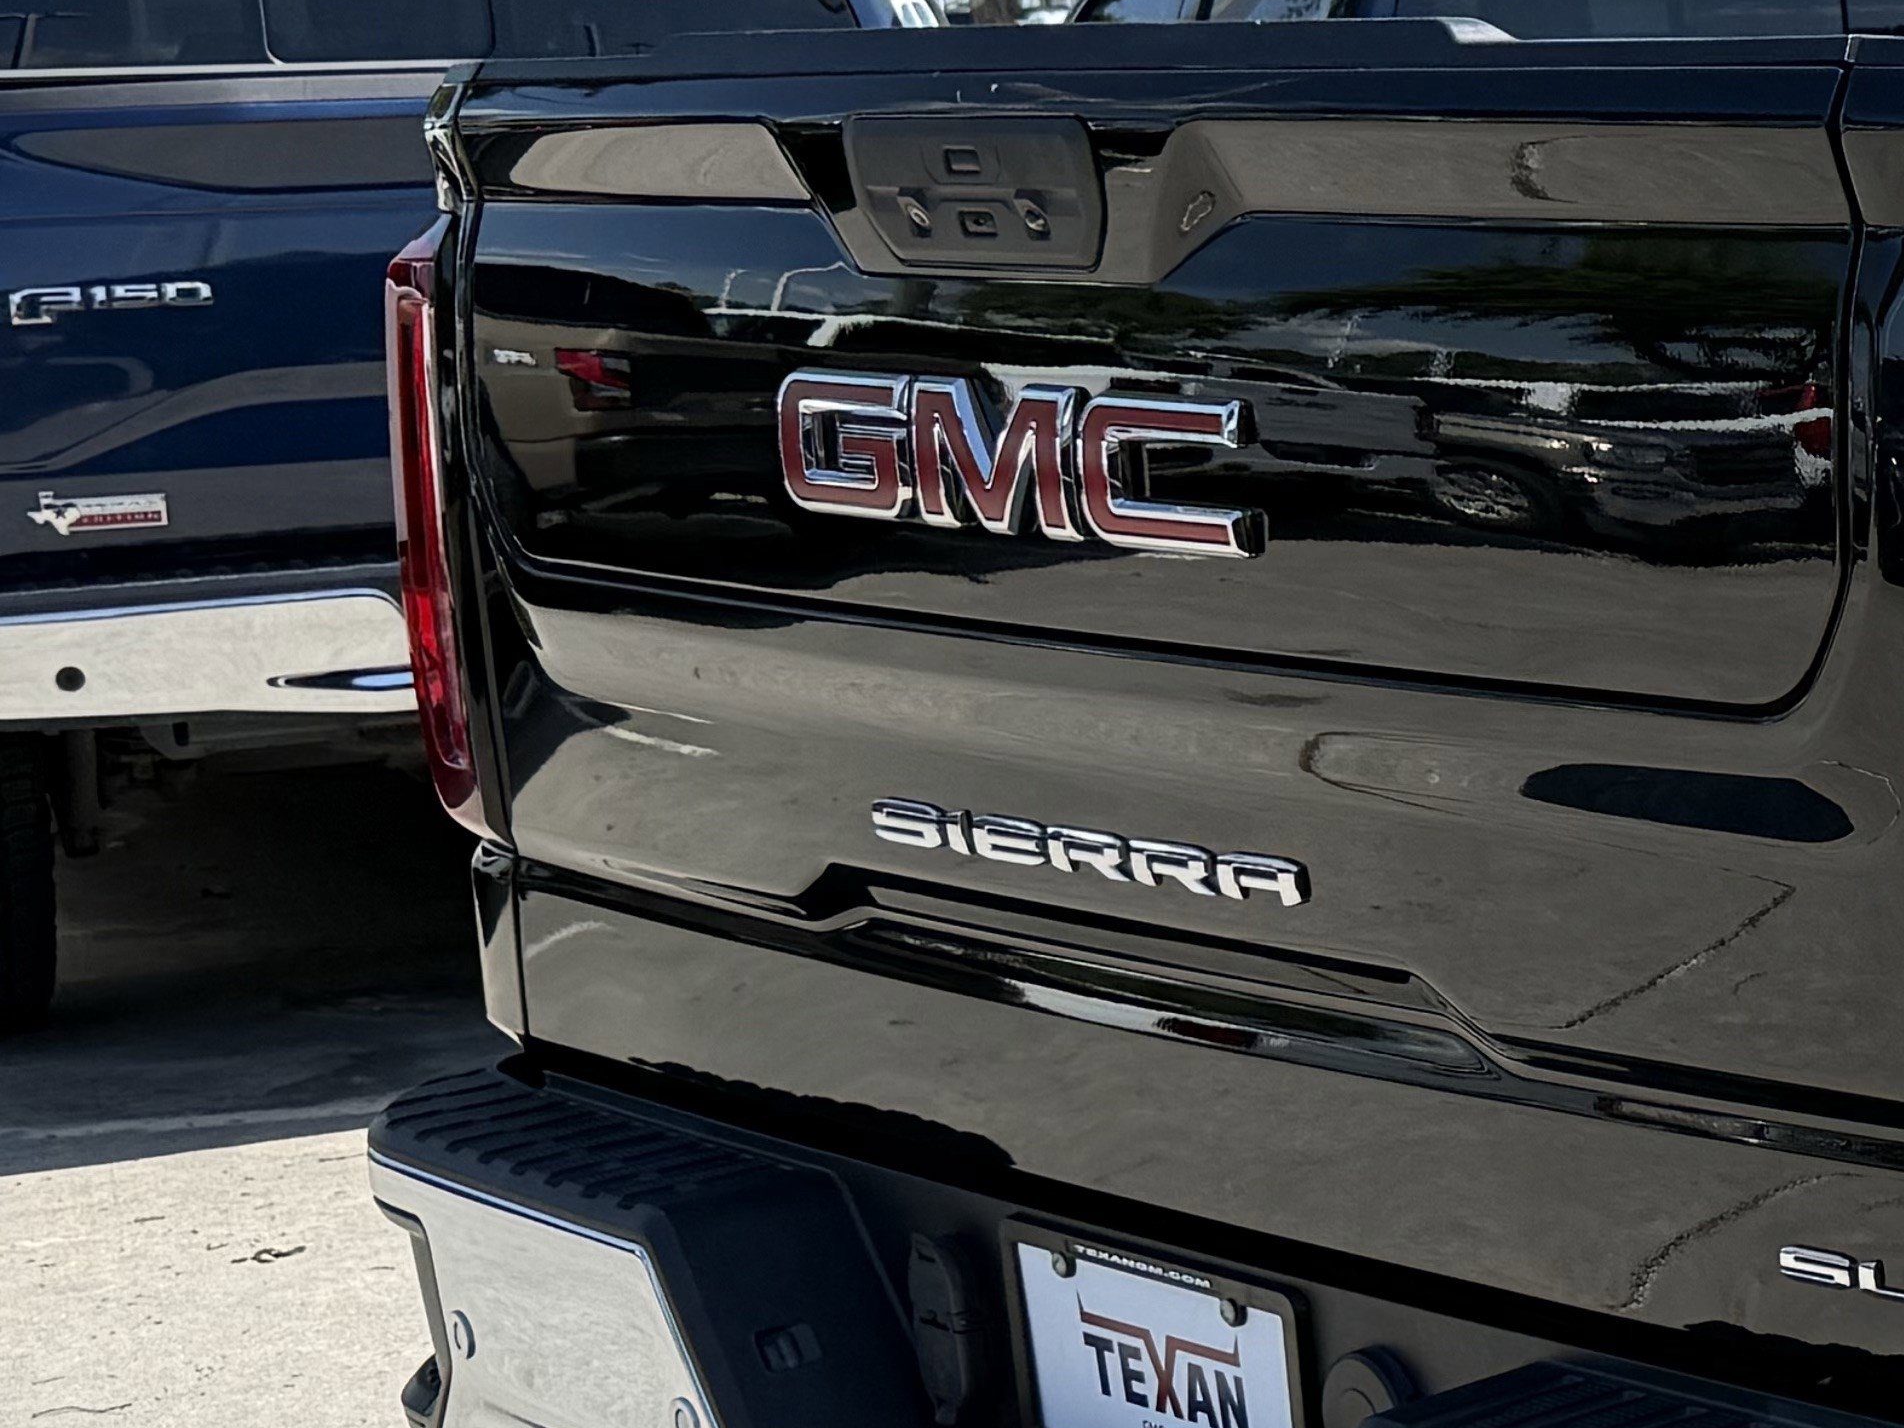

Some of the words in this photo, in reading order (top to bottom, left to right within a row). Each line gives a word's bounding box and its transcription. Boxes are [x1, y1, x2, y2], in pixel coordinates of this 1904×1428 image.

[777, 370, 1268, 559] GMC
[870, 795, 1312, 908] SIERRA
[1072, 1242, 1212, 1290] TEXANGM.COM
